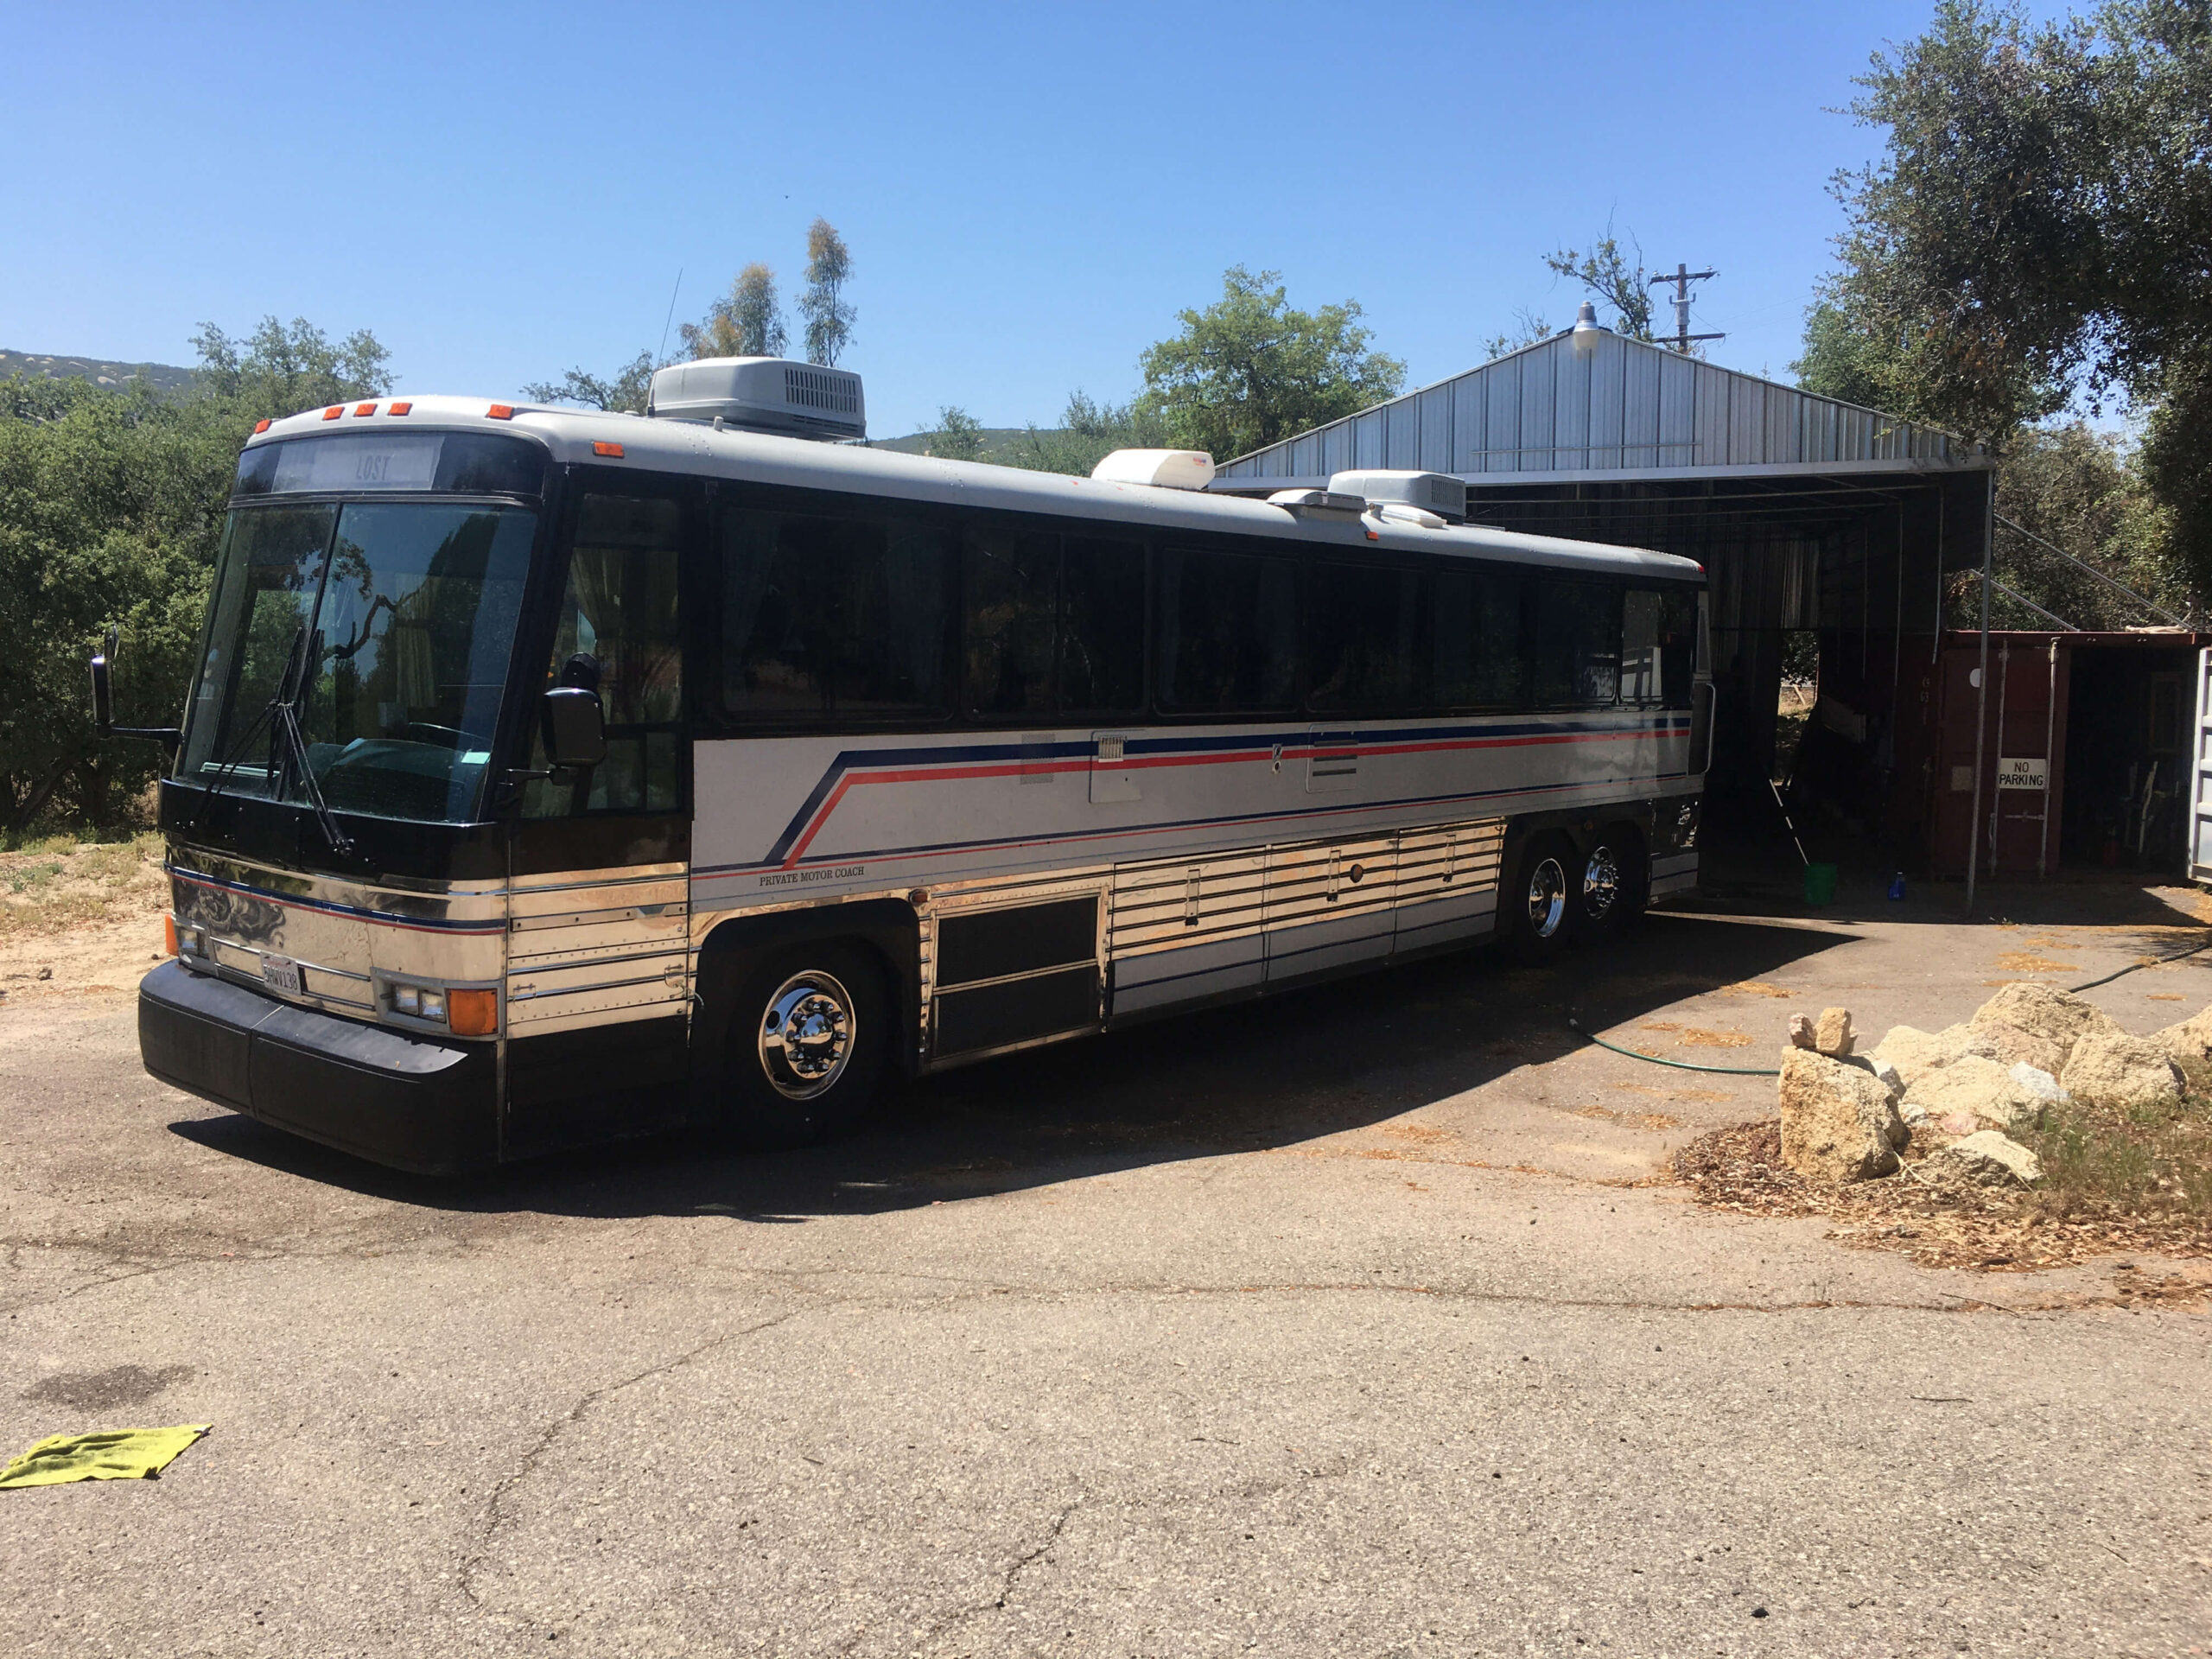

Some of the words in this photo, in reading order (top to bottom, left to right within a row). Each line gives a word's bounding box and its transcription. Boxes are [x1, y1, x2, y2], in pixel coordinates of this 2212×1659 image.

[356, 455, 391, 480] LOST
[2014, 761, 2030, 772] NO
[1999, 773, 2044, 785] PARKING
[760, 873, 798, 887] PRIVATE
[801, 869, 833, 882] MOTOR
[835, 866, 865, 878] COACH
